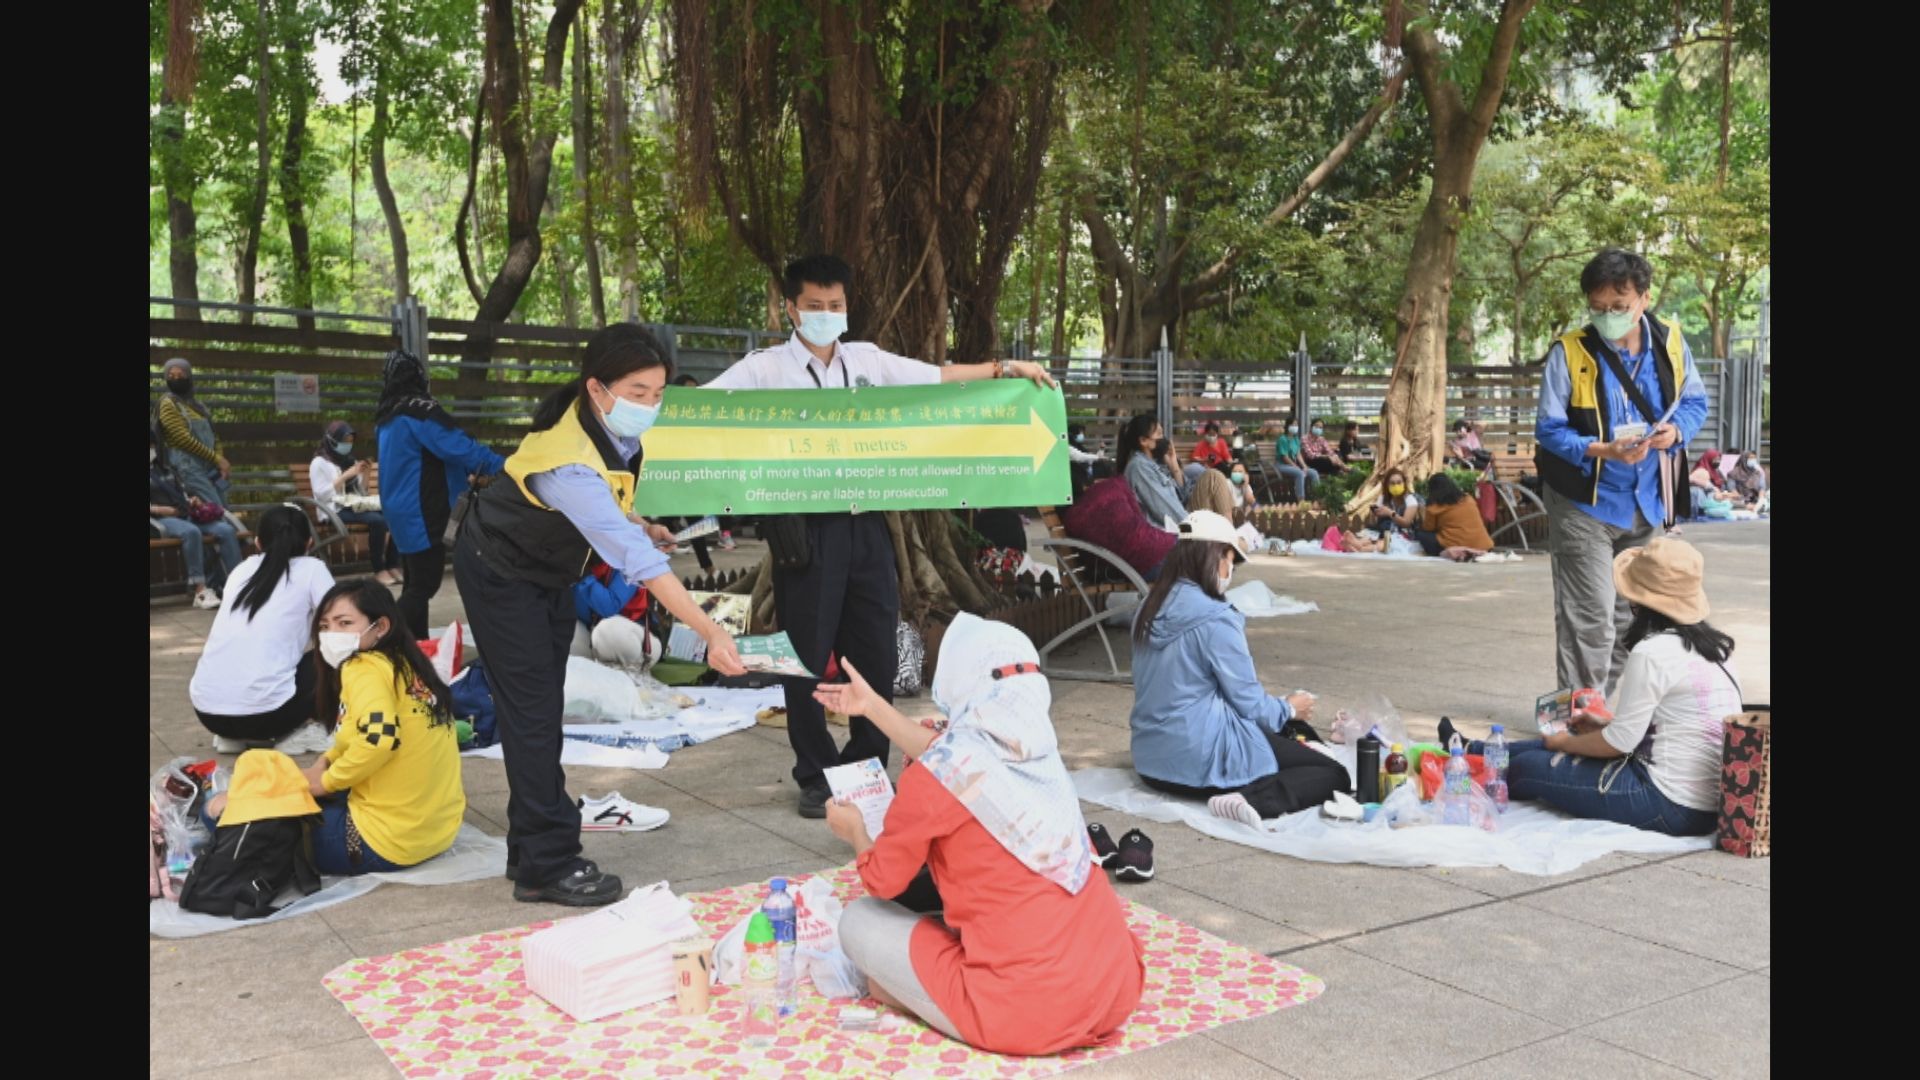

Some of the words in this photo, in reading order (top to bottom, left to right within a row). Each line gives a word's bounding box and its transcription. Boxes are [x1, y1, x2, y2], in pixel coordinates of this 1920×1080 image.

[799, 409, 807, 420] 4
[789, 438, 812, 453] 1.5
[826, 437, 840, 455] 米
[854, 438, 907, 453] metres
[684, 467, 747, 483] gathering
[750, 466, 763, 479] of
[767, 468, 800, 479] more
[803, 466, 831, 478] than
[835, 468, 843, 478] 4
[845, 465, 885, 480] people
[888, 464, 897, 477] is
[900, 465, 919, 477] not
[921, 464, 962, 476] allowed
[963, 464, 974, 475] in
[976, 464, 996, 475] this
[998, 465, 1030, 474] venue
[745, 488, 808, 501] Offenders
[810, 489, 831, 500] are
[833, 486, 865, 499] liable
[868, 487, 880, 499] to
[883, 486, 949, 500] prosecution
